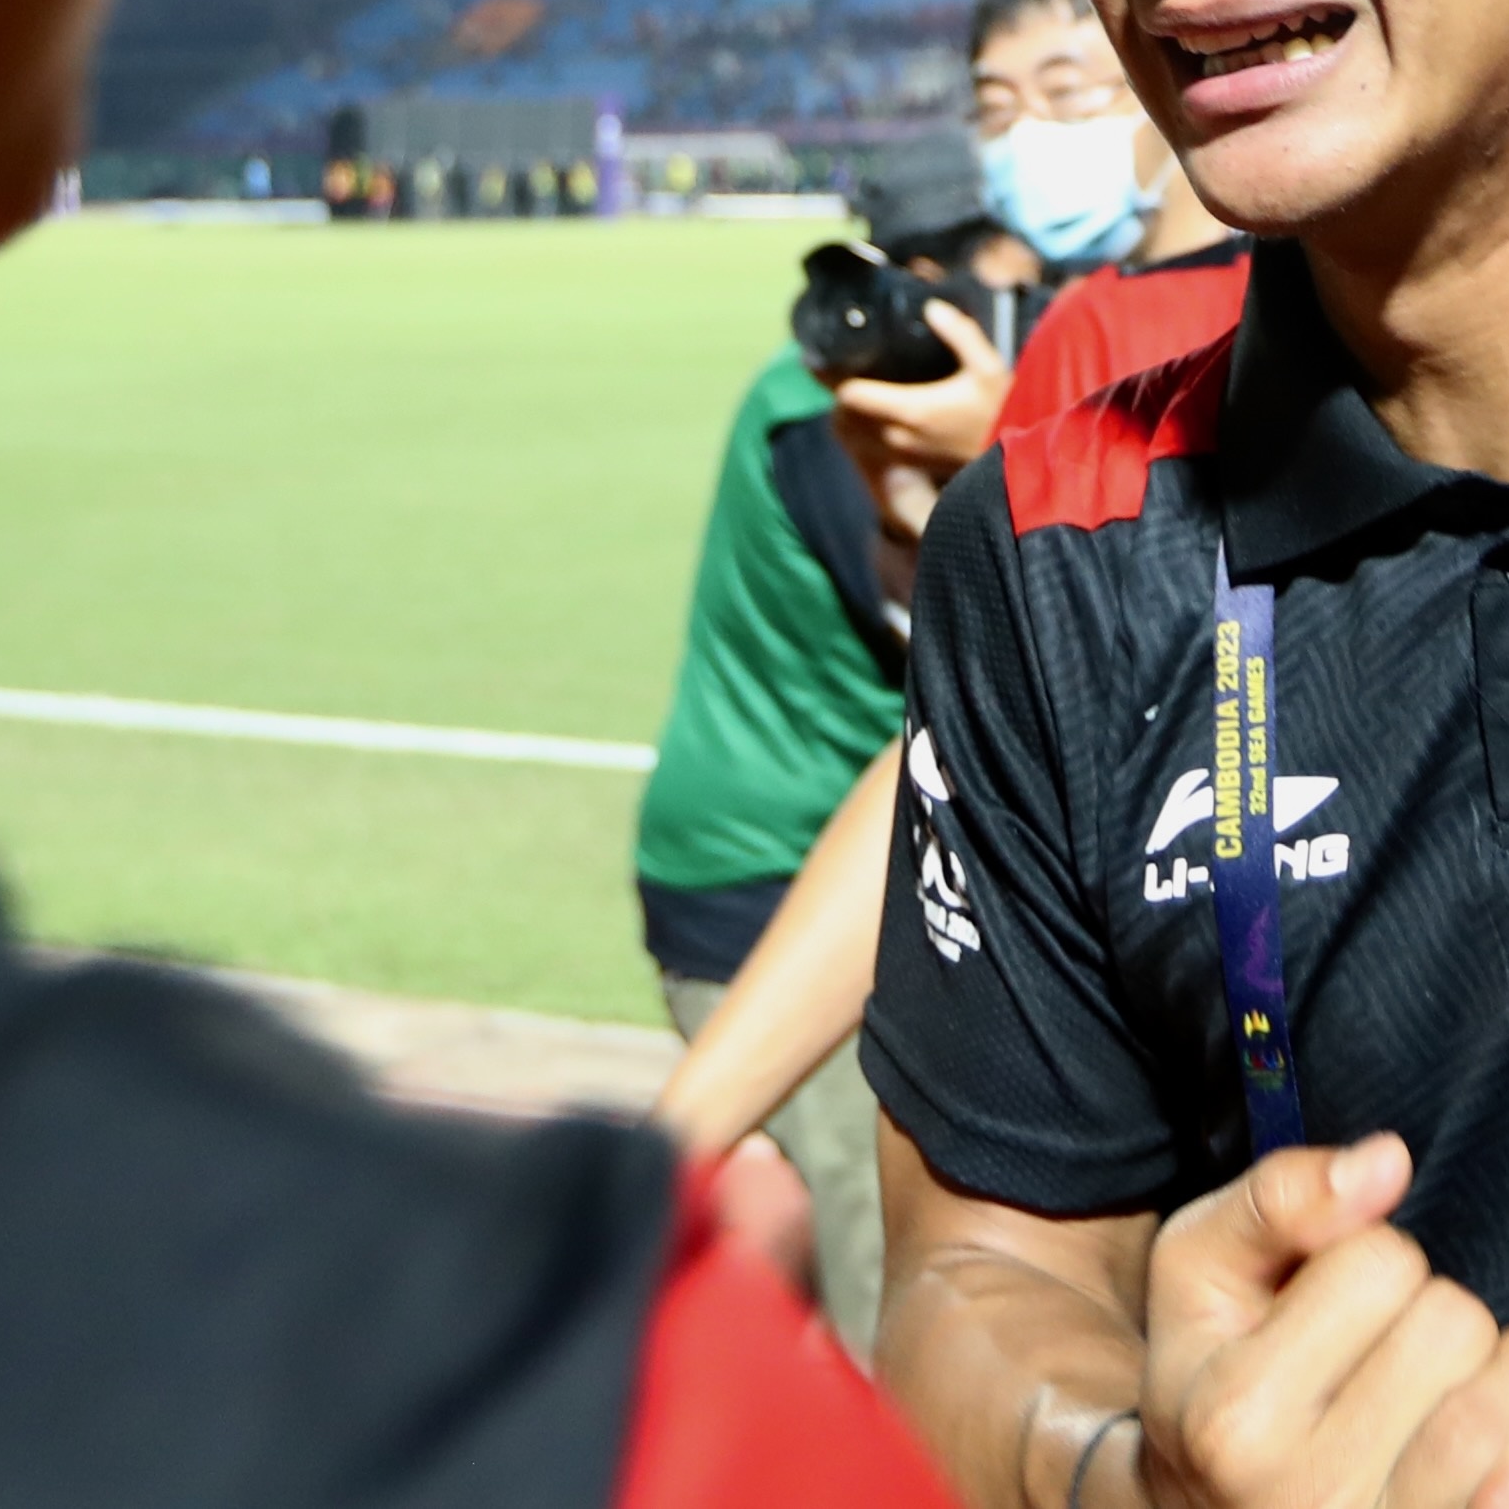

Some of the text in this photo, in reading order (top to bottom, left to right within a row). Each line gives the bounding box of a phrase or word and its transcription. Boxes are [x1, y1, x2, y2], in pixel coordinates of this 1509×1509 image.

[1215, 620, 1242, 859] CAMBODIA 2023
[1246, 655, 1267, 816] 32nd SEA GAMES
[1143, 832, 1350, 902] LI-NG
